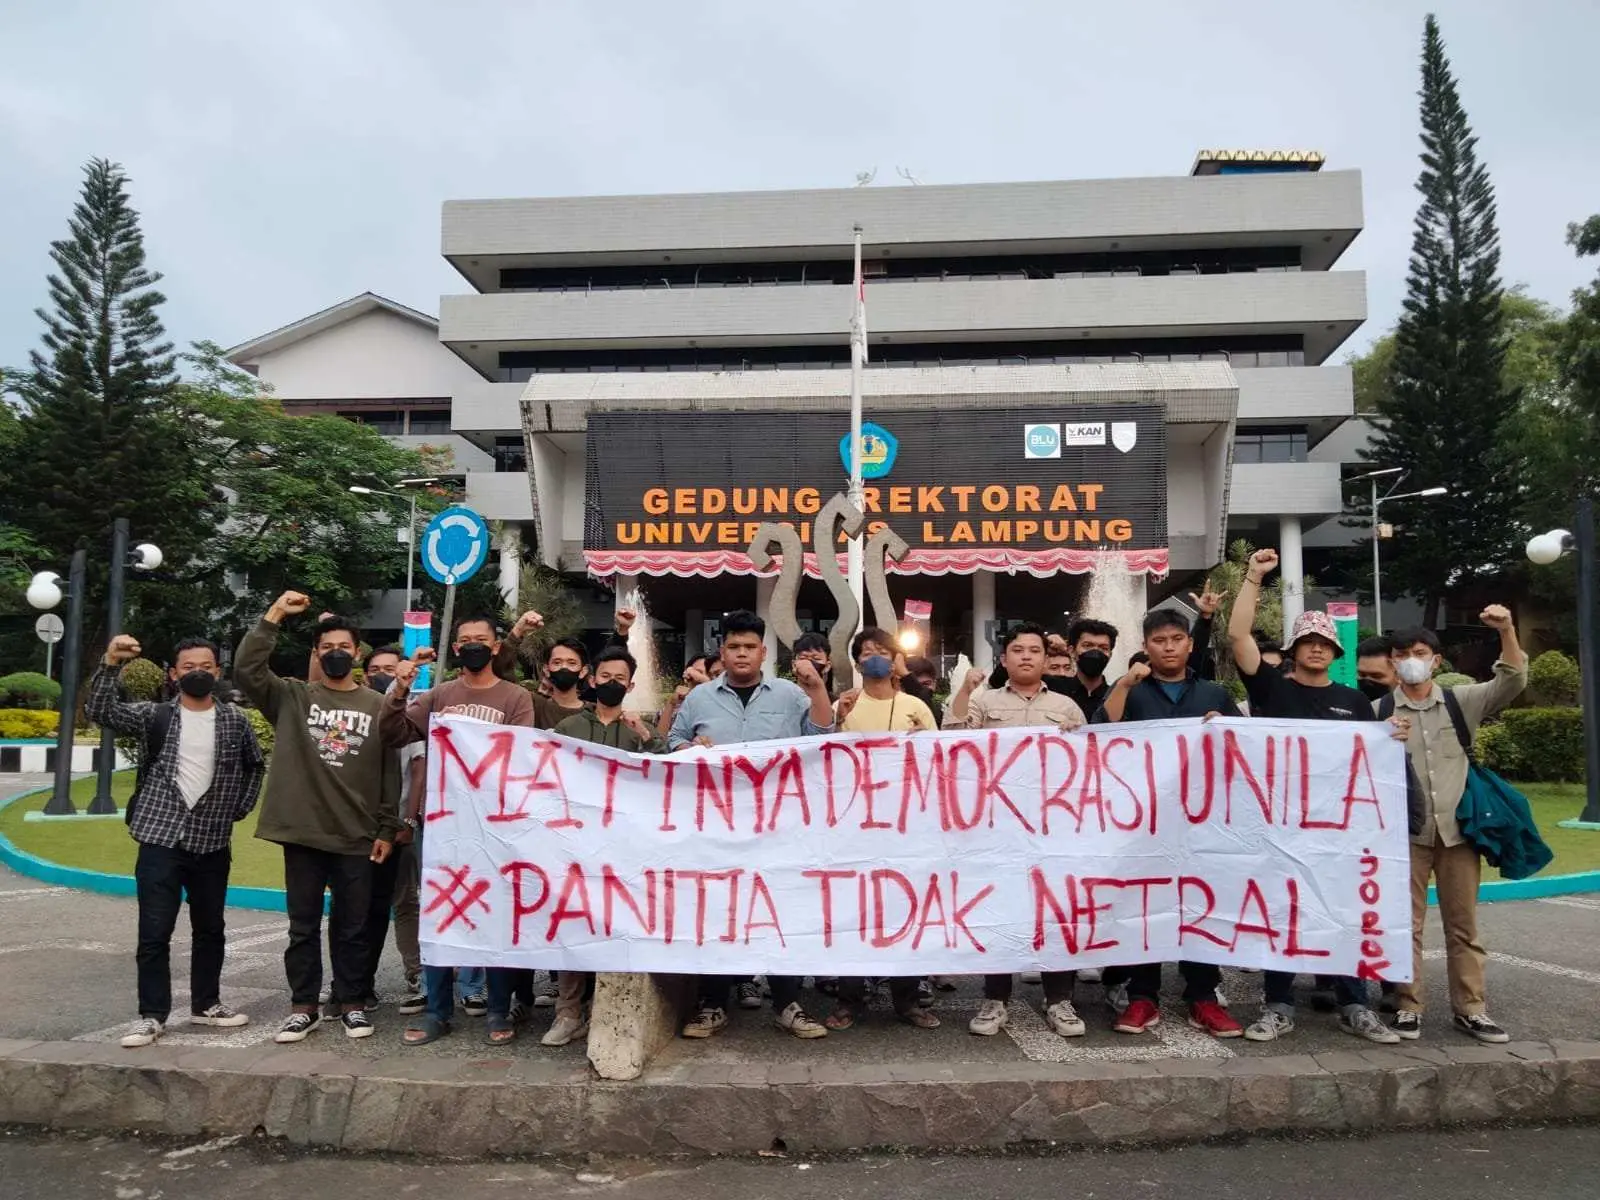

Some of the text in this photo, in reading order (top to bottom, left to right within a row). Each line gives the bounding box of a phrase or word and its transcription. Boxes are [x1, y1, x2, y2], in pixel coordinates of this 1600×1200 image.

[1031, 434, 1055, 444] BLU
[1077, 426, 1102, 436] KAN
[643, 484, 1103, 515] GEDUNG REKTORAT
[923, 519, 1133, 543] LAMPUNG
[307, 703, 372, 737] SMITH
[819, 731, 1157, 835] DEMOKRASI
[1178, 729, 1385, 830] UNILA
[802, 868, 994, 954] TIDAK
[1032, 865, 1331, 957] NETRAL
